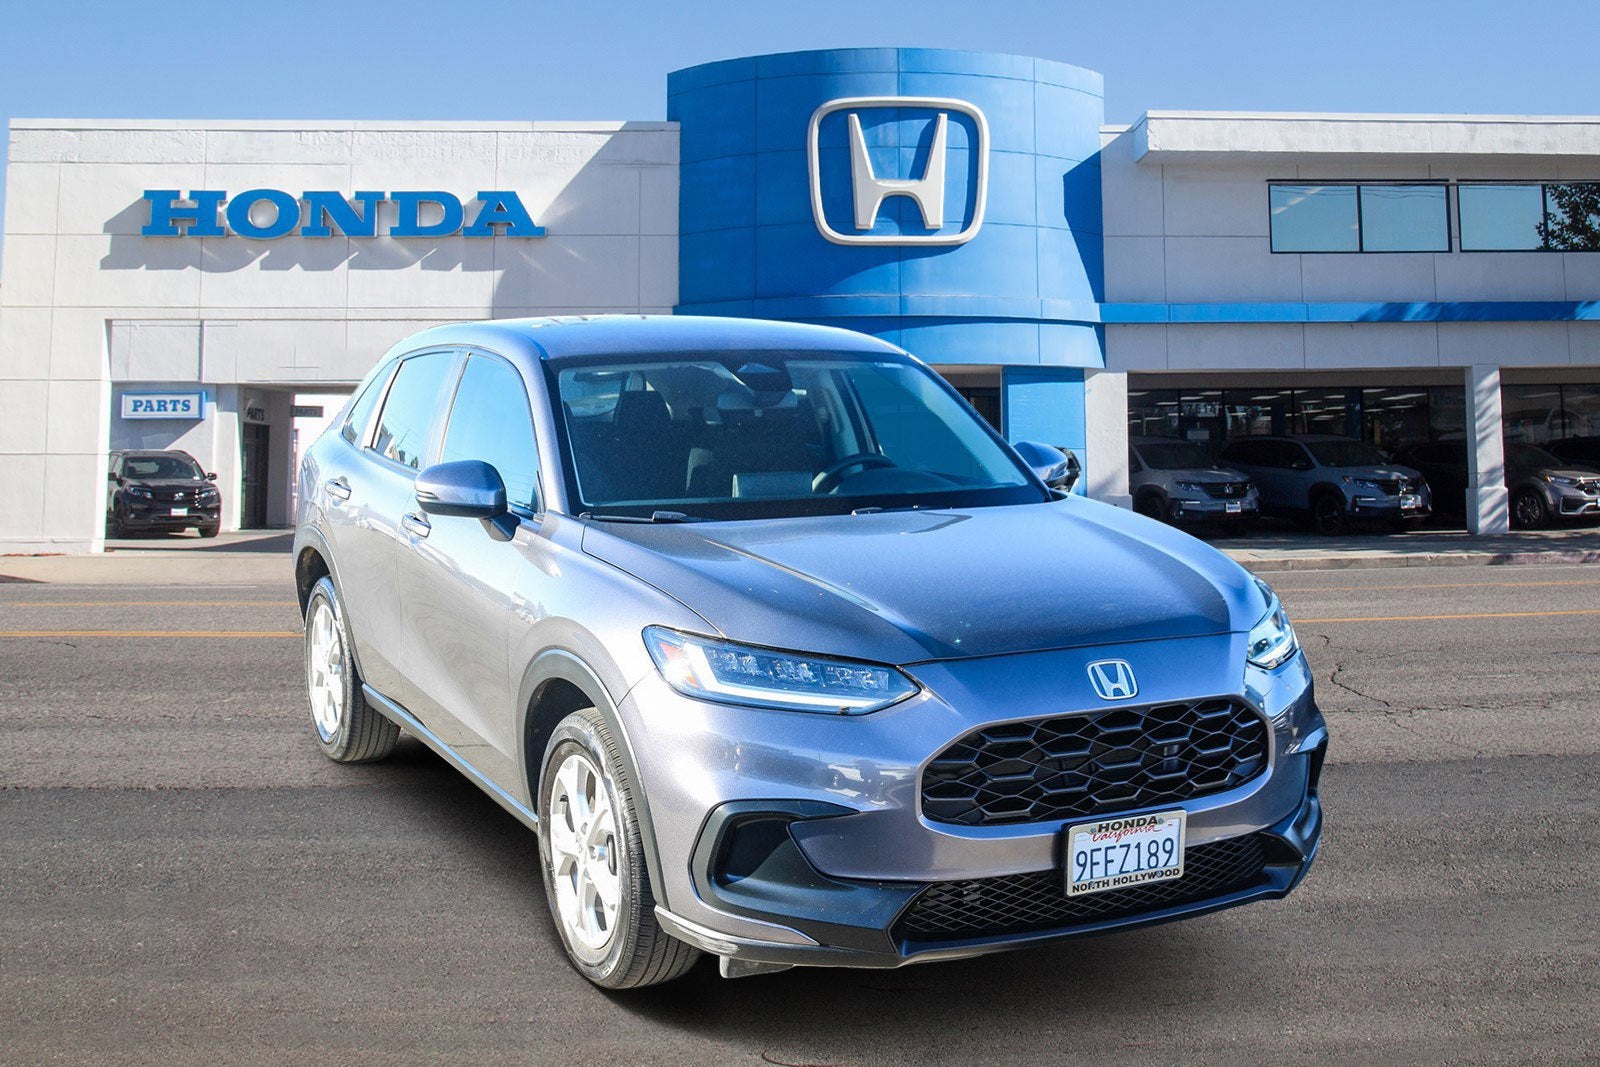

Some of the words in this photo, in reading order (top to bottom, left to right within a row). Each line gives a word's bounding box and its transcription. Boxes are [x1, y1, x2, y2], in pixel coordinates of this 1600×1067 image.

[141, 188, 547, 240] HONDA
[132, 399, 191, 412] PARTS
[247, 407, 264, 422] PARTS
[1098, 816, 1158, 833] HONDA
[1075, 837, 1174, 883] 9FFZ189
[1113, 868, 1180, 886] HOLLYWOOD
